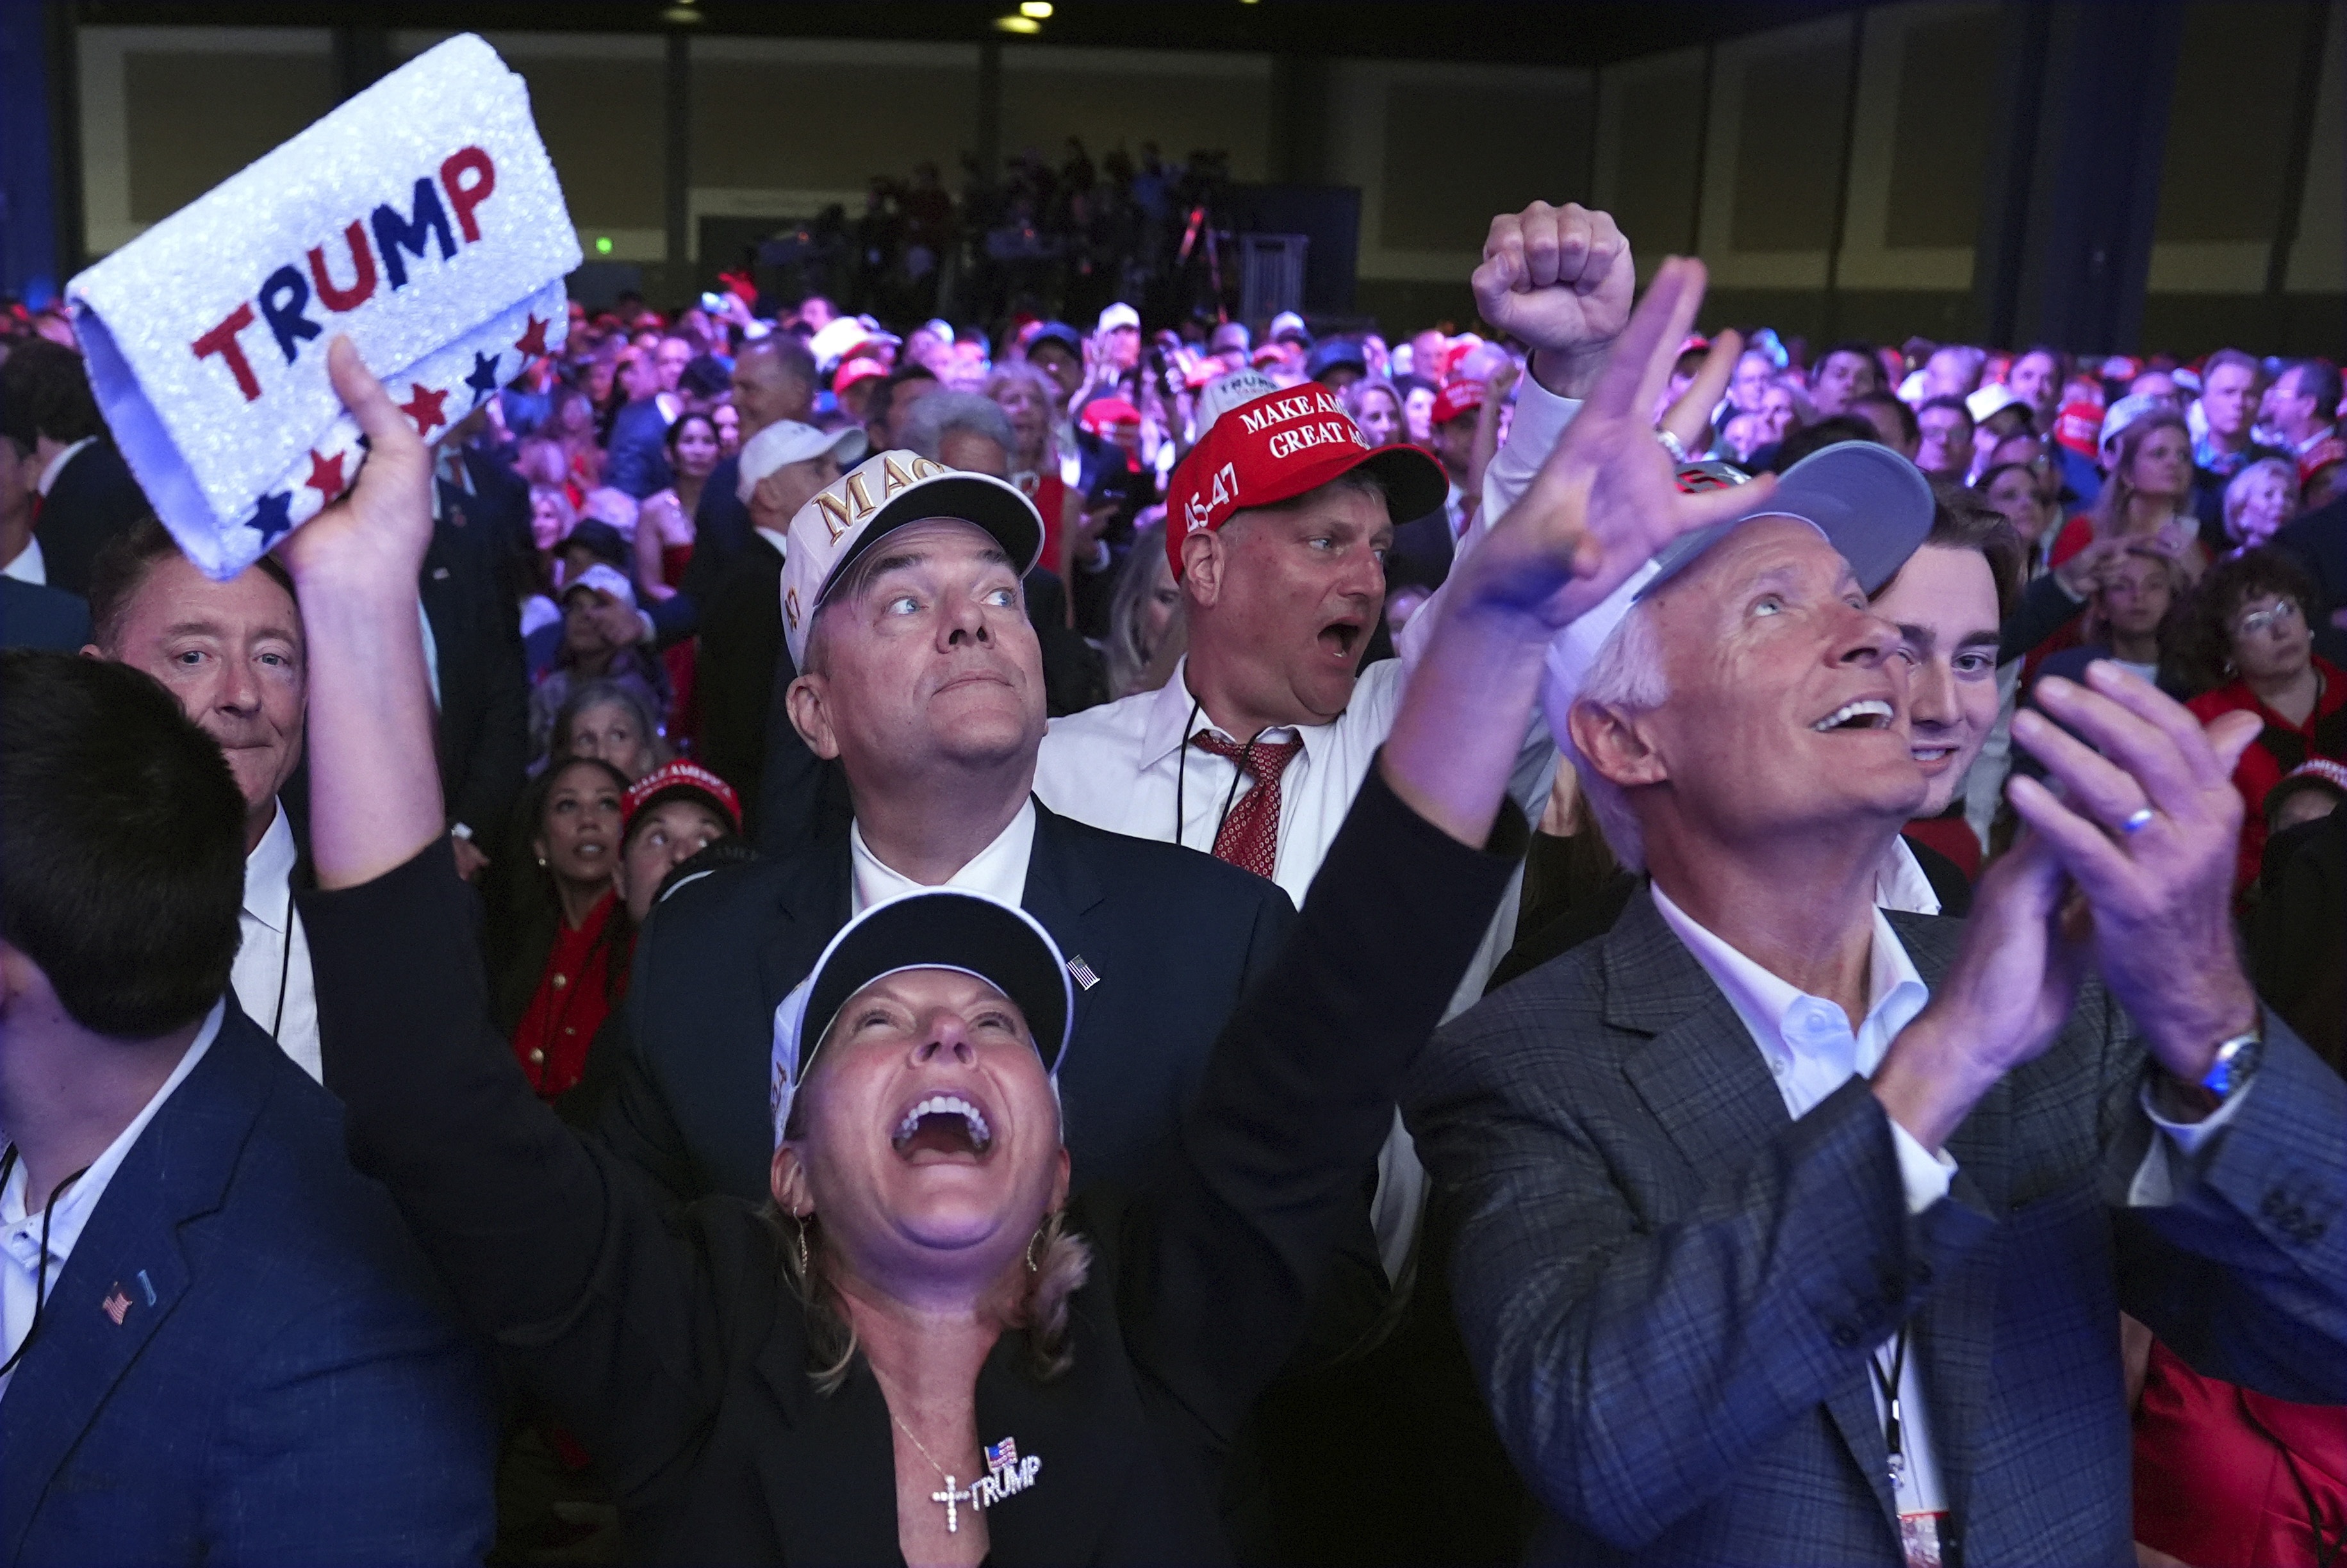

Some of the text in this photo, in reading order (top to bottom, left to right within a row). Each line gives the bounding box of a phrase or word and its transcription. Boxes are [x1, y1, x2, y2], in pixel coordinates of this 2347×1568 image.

[191, 145, 495, 402] TRUMP
[1239, 395, 1315, 434] MAKE
[1269, 422, 1346, 459] GREAT
[1184, 461, 1239, 533] 45-47
[969, 1455, 1041, 1511] TRUMP
